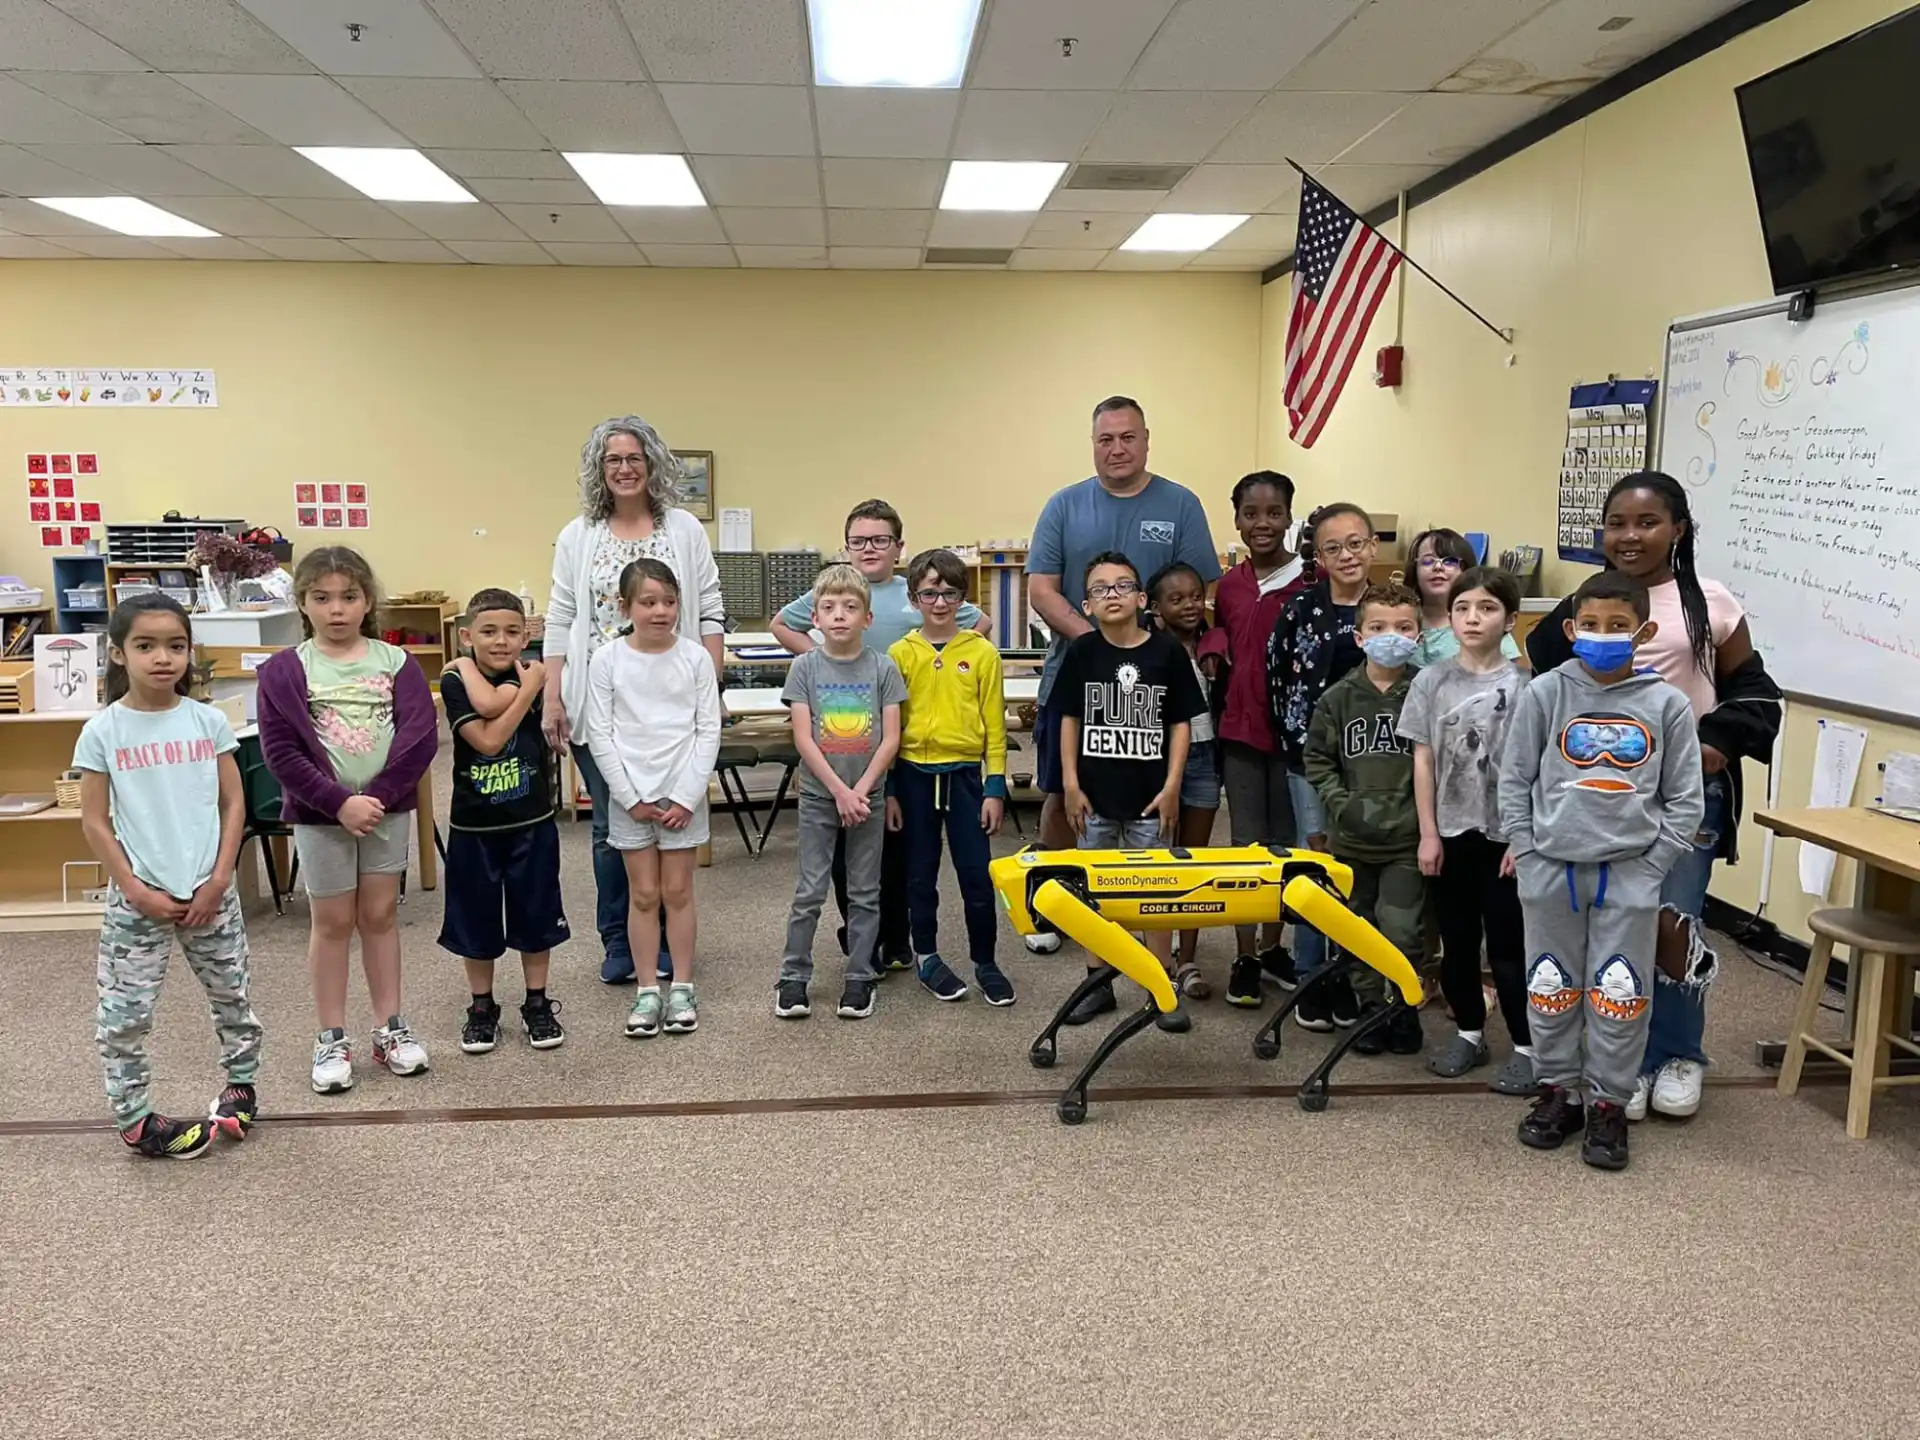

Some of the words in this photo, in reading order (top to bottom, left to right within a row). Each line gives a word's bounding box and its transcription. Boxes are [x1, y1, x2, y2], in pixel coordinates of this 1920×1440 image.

[16, 371, 26, 381] Rr
[37, 371, 47, 382] Ss
[56, 371, 67, 381] Tt
[100, 371, 113, 381] Vv
[120, 371, 139, 382] Ww
[147, 371, 159, 382] Xx
[169, 371, 182, 385] Yy
[193, 371, 204, 382] Zz
[1586, 409, 1604, 422] May
[1737, 417, 1758, 440] Good
[1577, 451, 1585, 464] 2
[1591, 451, 1597, 464] 3
[1603, 451, 1609, 464] 4
[1615, 451, 1620, 464] 5
[1625, 451, 1631, 464] 6
[1637, 450, 1643, 464] 7
[1565, 470, 1571, 483] 8
[1577, 471, 1583, 484] 9
[1588, 471, 1598, 484] 10
[1602, 471, 1609, 485] 11
[1562, 490, 1571, 503] 15
[1575, 491, 1584, 503] 16
[1587, 491, 1596, 504] 17
[1561, 511, 1572, 524] 22
[1573, 511, 1583, 524] 23
[1560, 530, 1569, 543] 29
[1573, 531, 1582, 544] 30
[1585, 531, 1593, 545] 31
[1084, 682, 1168, 728] PURE
[1086, 728, 1163, 758] GENIUS
[1344, 713, 1413, 759] GA
[115, 742, 162, 772] PEACE
[164, 741, 183, 764] OF
[470, 756, 520, 781] SPACE
[480, 772, 520, 795] JAM
[1141, 904, 1169, 913] CODE
[1171, 903, 1179, 913] &
[1181, 903, 1223, 913] CIRCUIT
